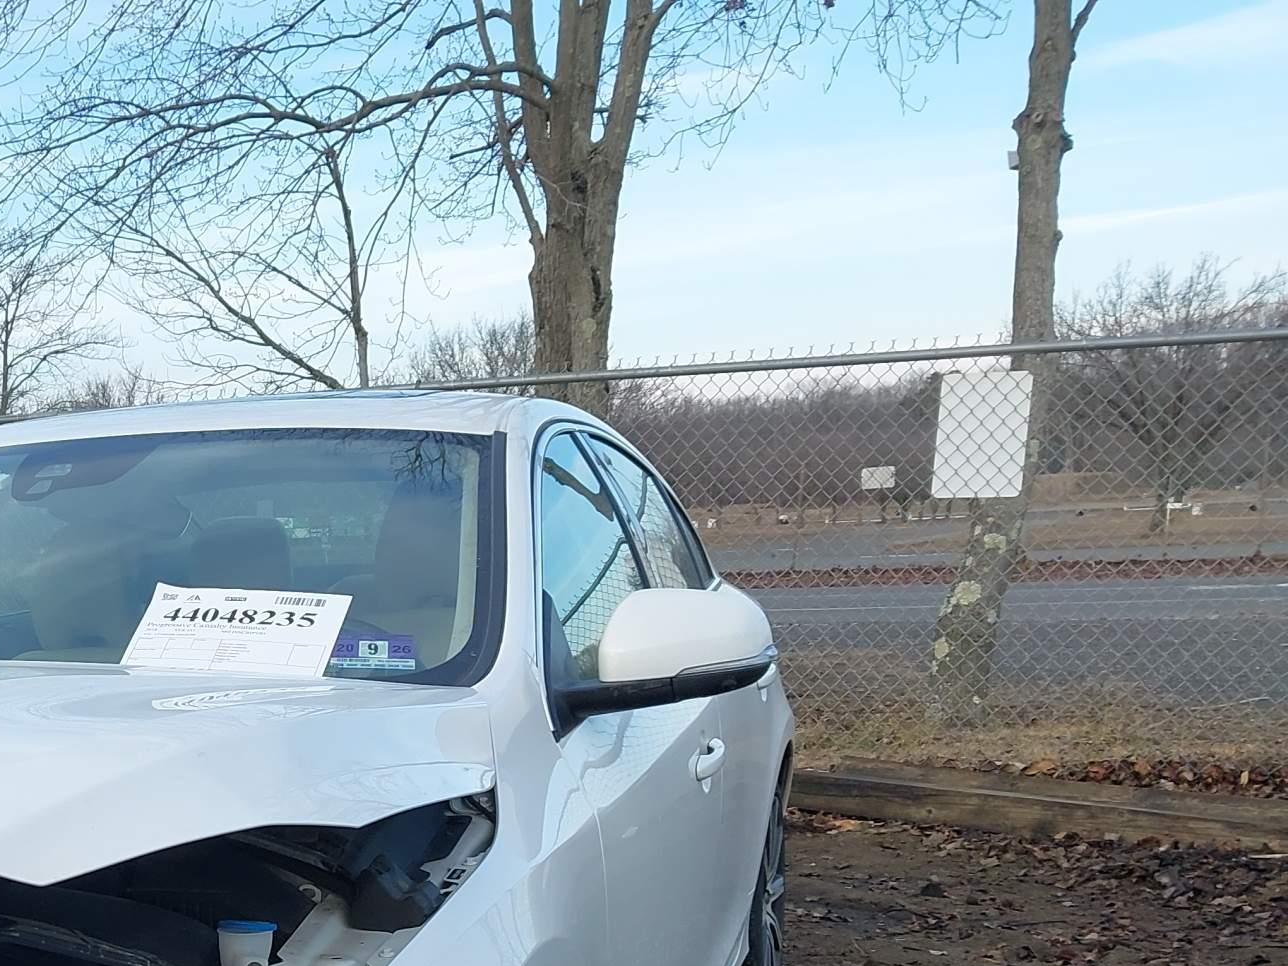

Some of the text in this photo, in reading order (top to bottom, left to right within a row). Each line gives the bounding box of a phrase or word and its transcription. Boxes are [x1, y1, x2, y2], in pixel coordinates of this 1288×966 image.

[163, 607, 318, 628] 44048235
[336, 643, 411, 655] 20 9 26
